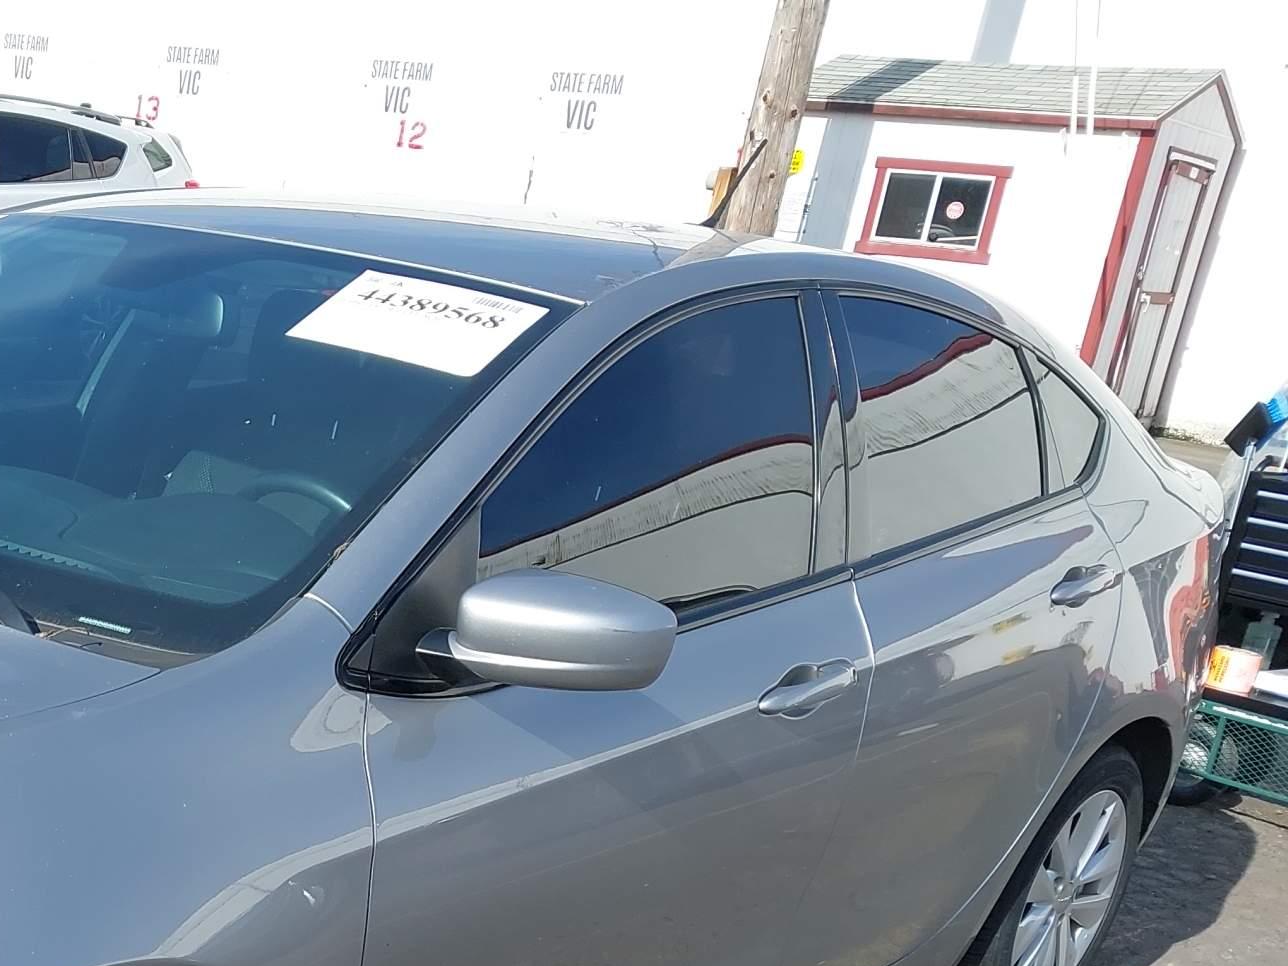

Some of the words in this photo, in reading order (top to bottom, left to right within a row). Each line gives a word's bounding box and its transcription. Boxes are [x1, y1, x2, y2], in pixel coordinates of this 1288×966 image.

[4, 33, 25, 50] STATE
[27, 36, 49, 52] FARM
[167, 45, 192, 64] STATE
[193, 47, 220, 66] FARM
[14, 55, 33, 80] VIC
[371, 59, 401, 80] STATE
[402, 61, 434, 81] FARM
[178, 69, 201, 96] VIC
[550, 71, 586, 94] STATE
[587, 73, 624, 96] FARM
[135, 94, 160, 121] 13
[384, 84, 411, 115] VIC
[566, 99, 597, 131] VIC
[395, 118, 428, 150] 12
[357, 289, 506, 329] 44389568
